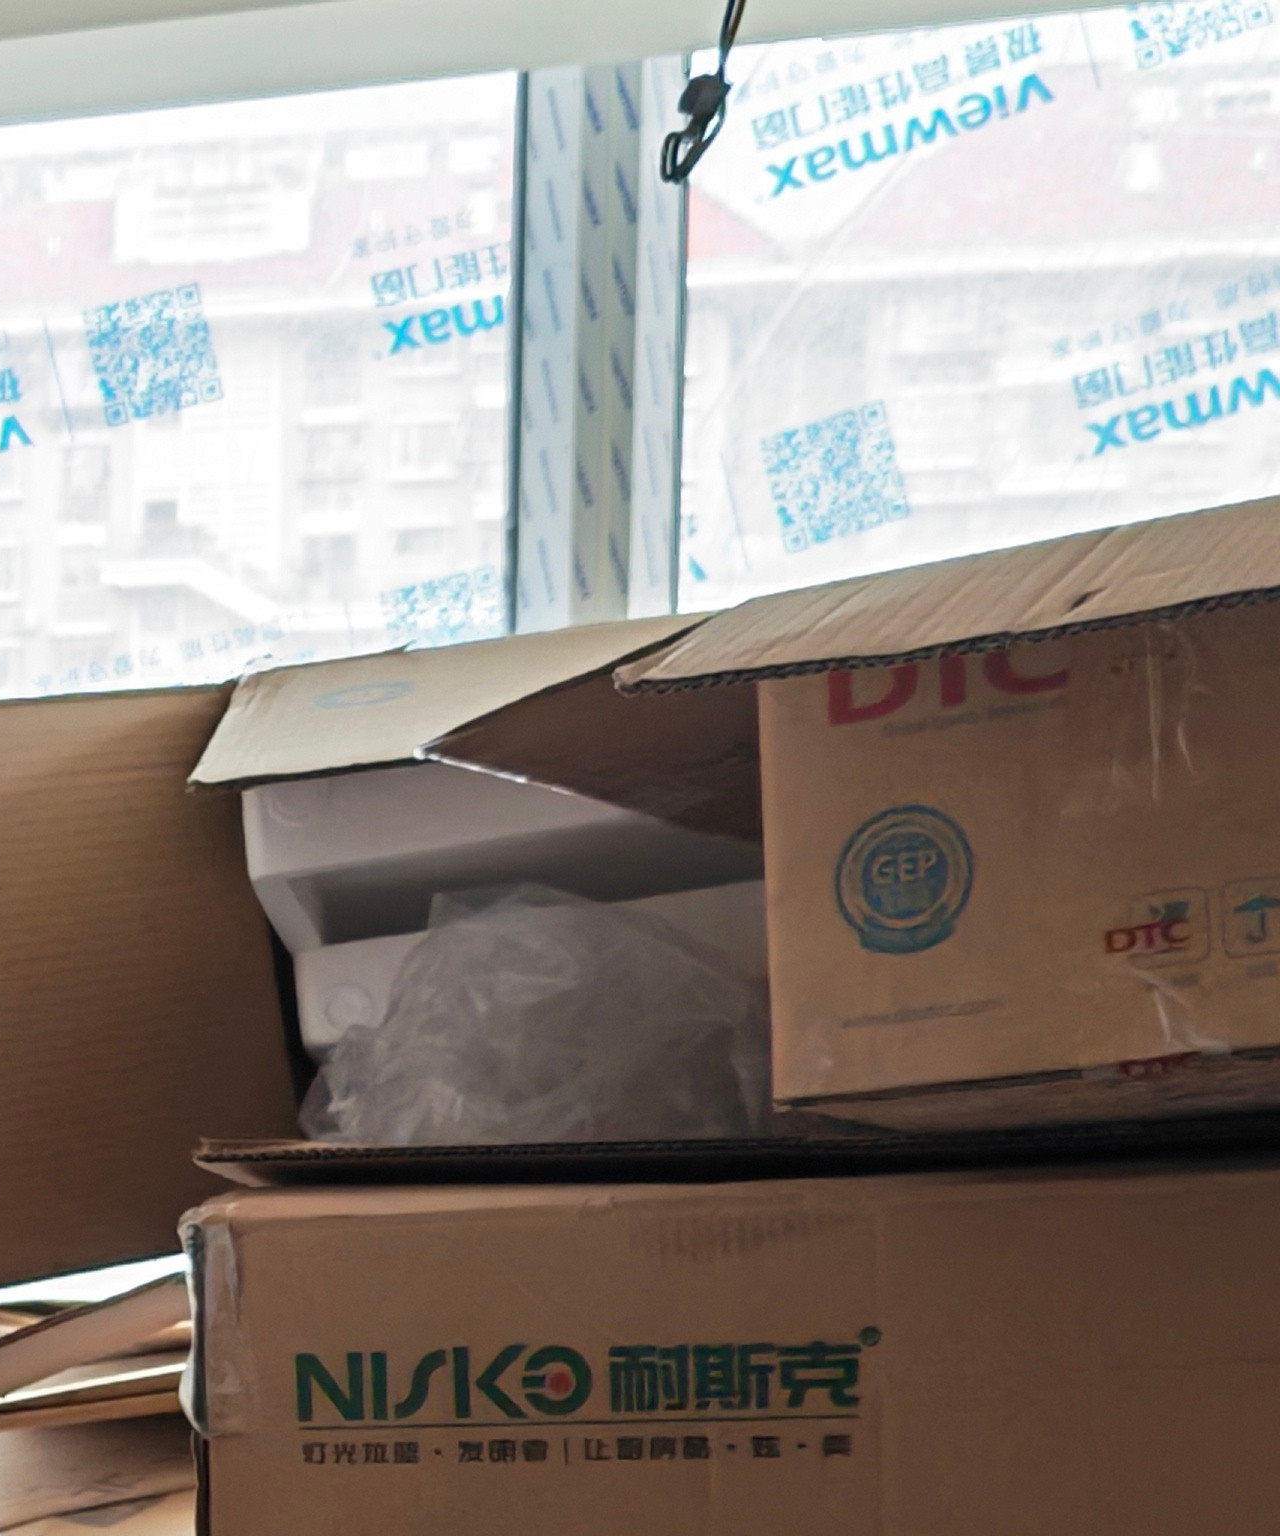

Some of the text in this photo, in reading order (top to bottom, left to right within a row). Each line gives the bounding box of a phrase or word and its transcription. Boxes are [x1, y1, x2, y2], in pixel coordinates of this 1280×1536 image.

[765, 73, 1055, 199] viewmax
[1104, 919, 1190, 954] DTC
[294, 1342, 862, 1421] NISKO 耐斯克
